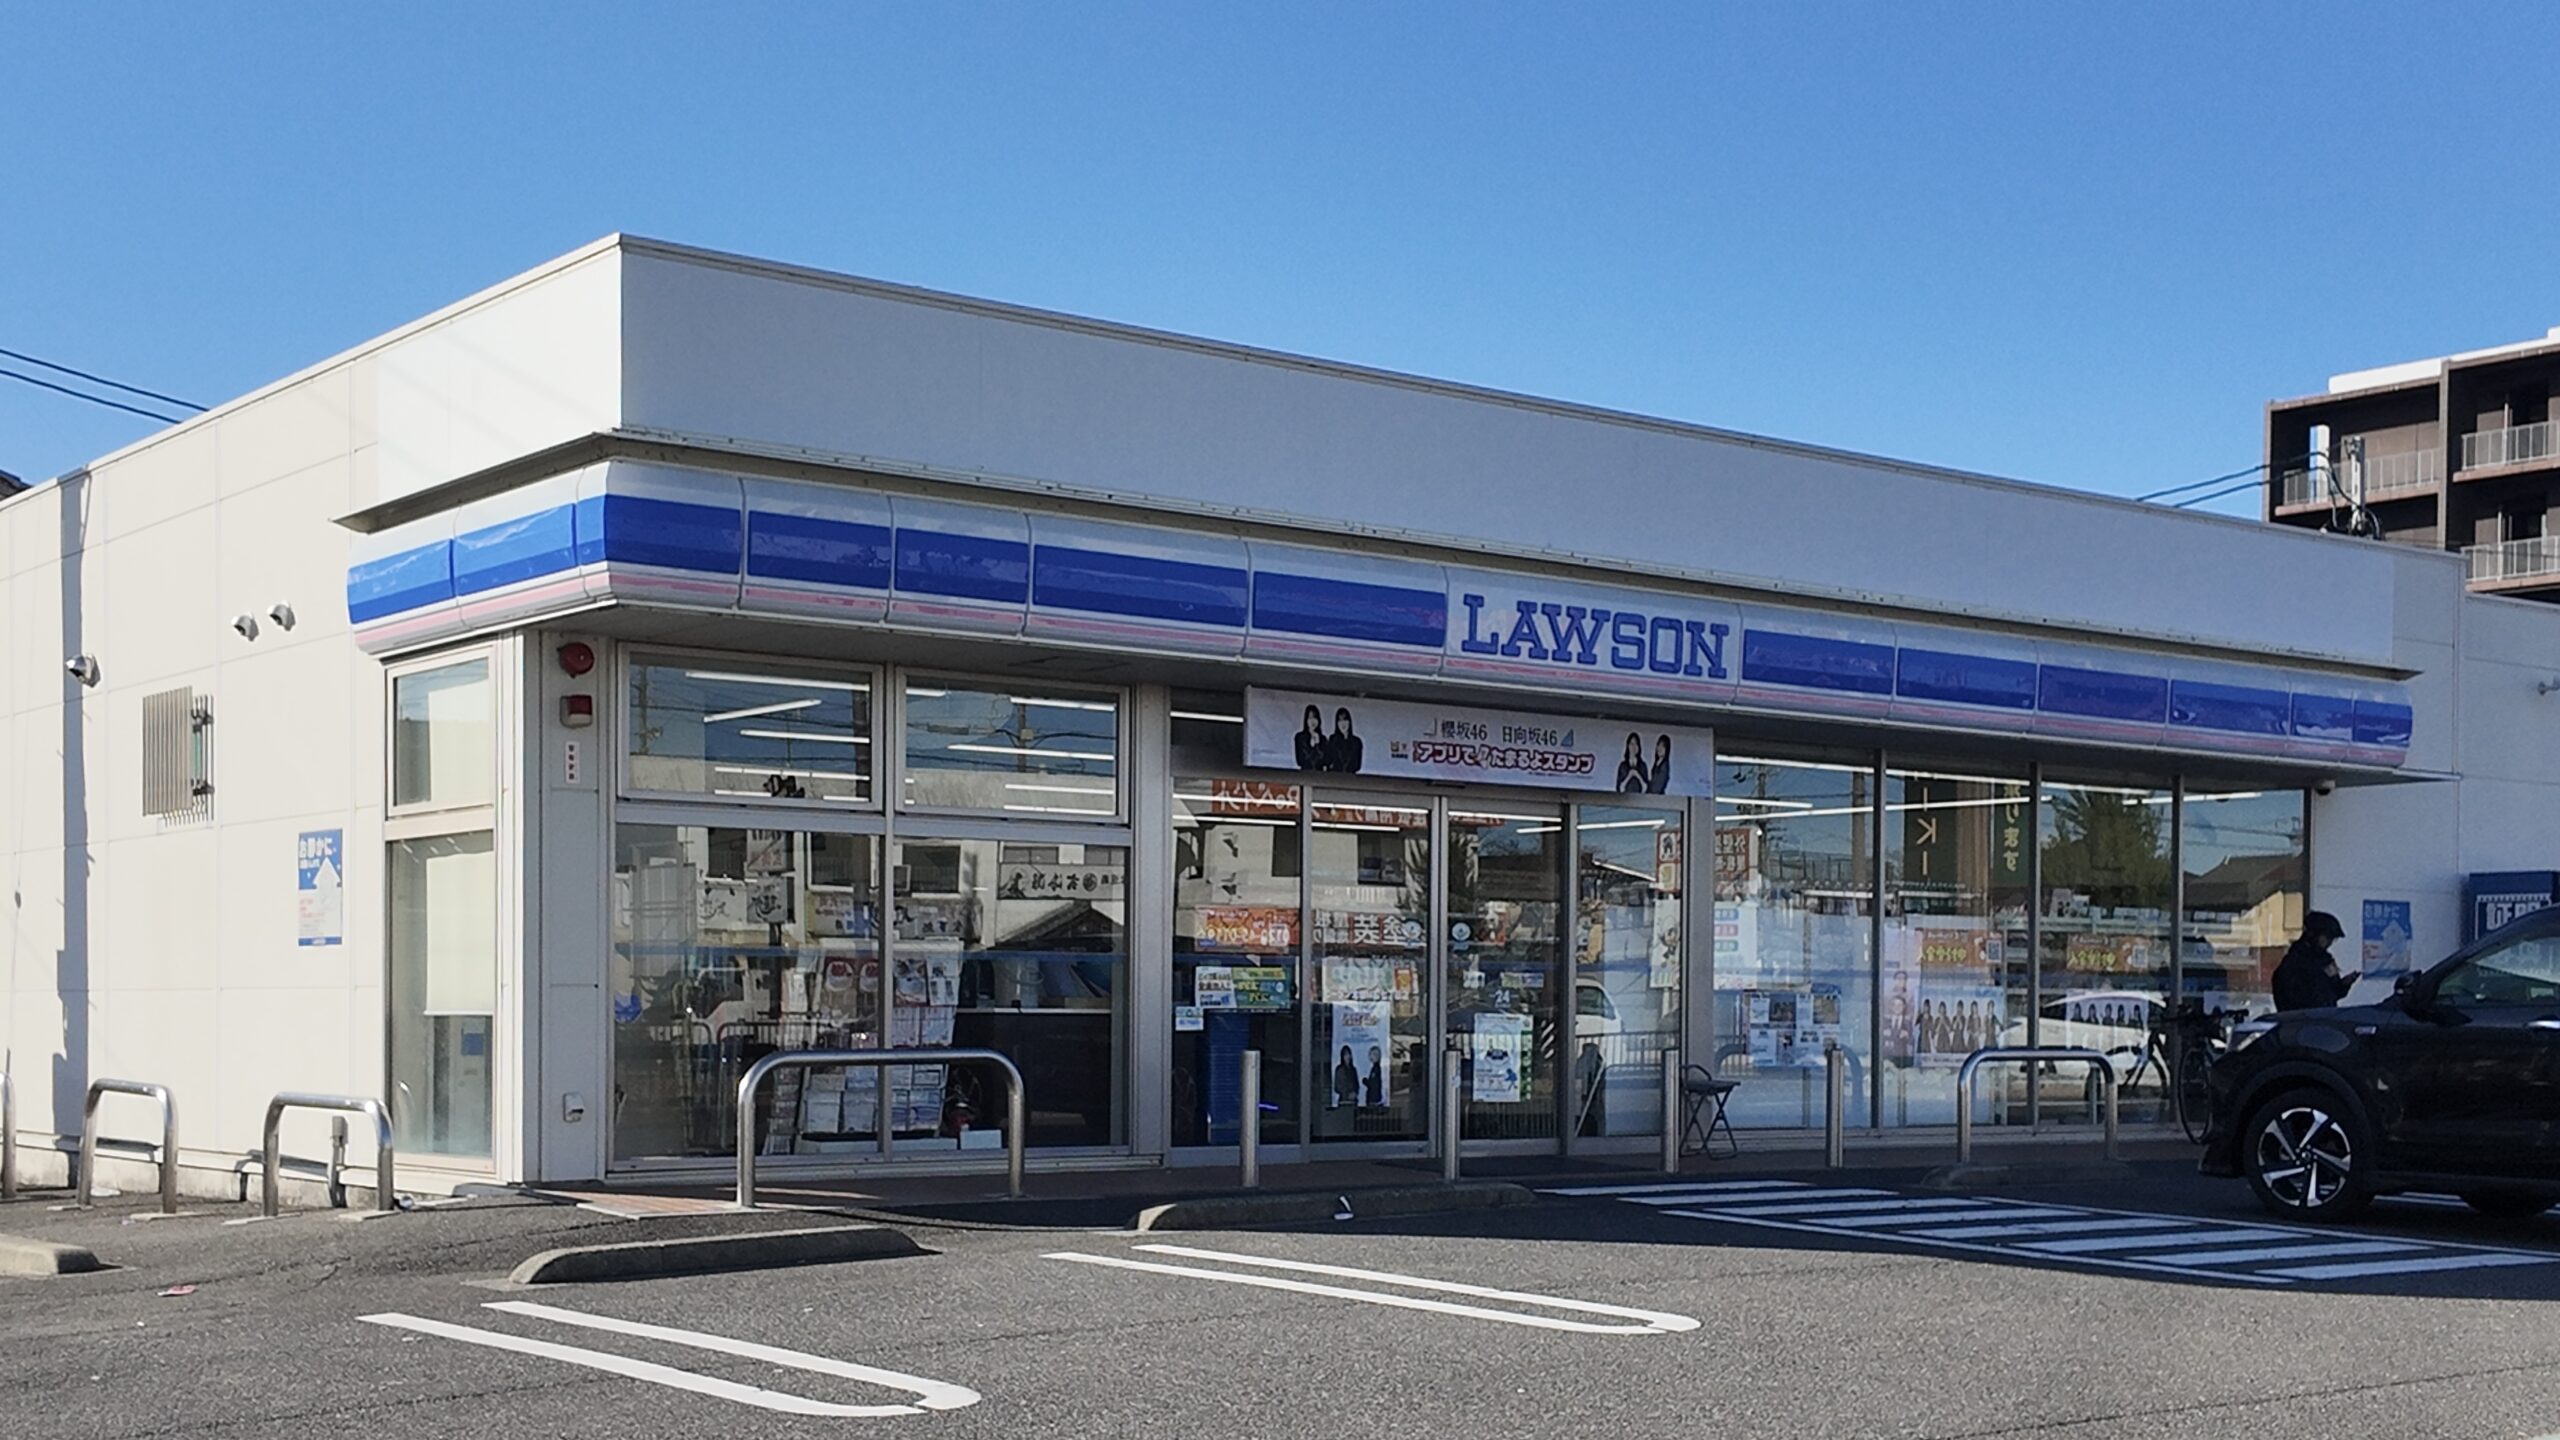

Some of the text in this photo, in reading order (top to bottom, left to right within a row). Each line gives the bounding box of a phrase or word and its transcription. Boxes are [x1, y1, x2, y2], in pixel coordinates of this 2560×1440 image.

[1461, 593, 1729, 679] LAWSON
[1502, 726, 1557, 746] 日向坂46
[1495, 989, 1510, 1003] 24
